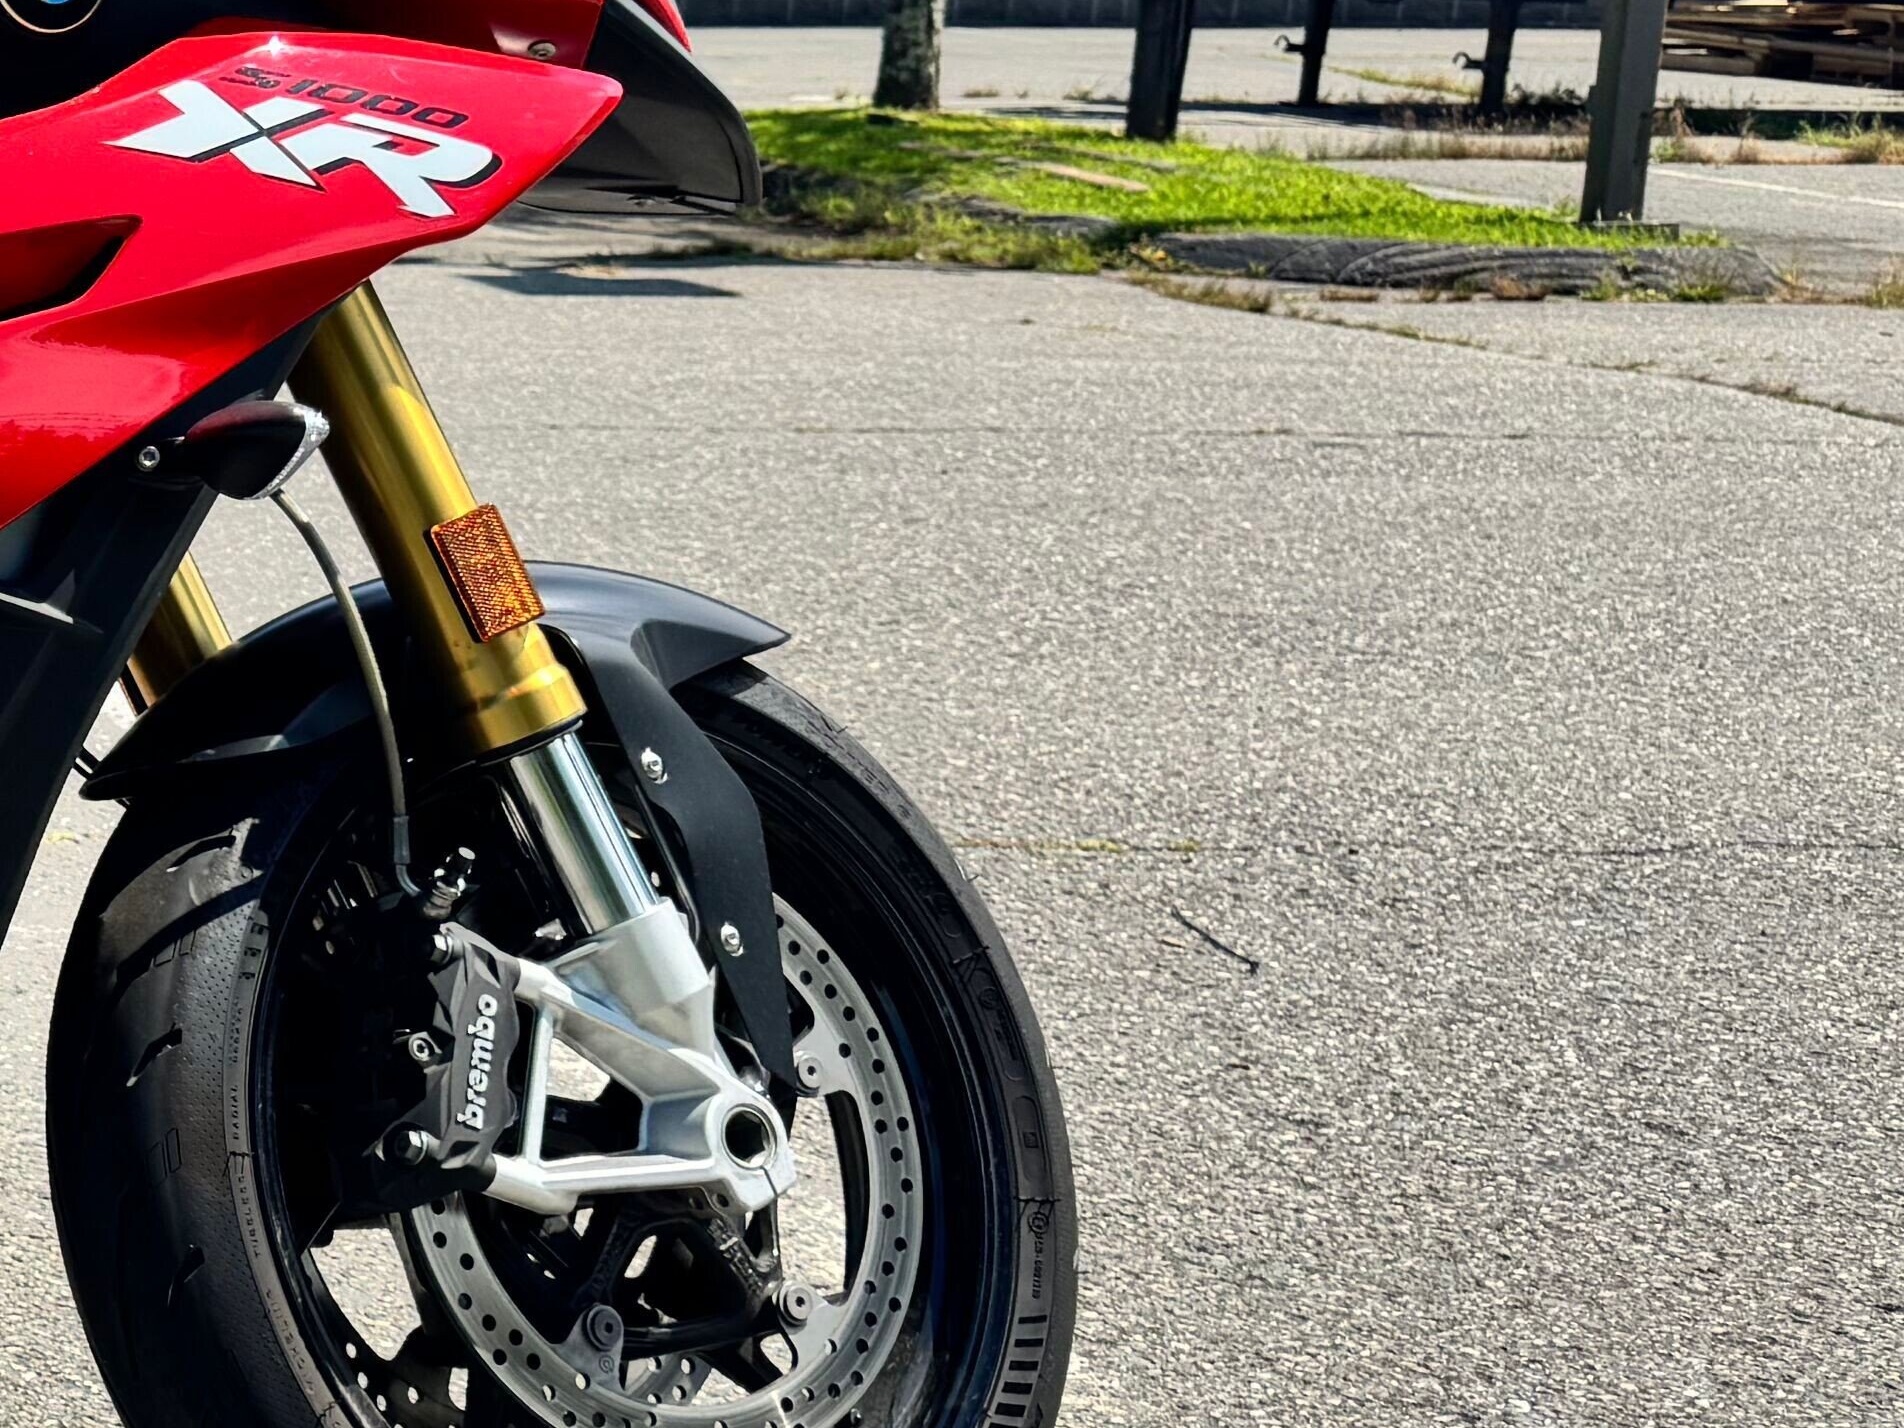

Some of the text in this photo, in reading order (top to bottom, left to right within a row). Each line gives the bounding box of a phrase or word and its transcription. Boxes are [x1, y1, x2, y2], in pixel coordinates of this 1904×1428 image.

[104, 79, 503, 220] XR
[286, 78, 470, 130] 1000
[456, 993, 499, 1130] brembo
